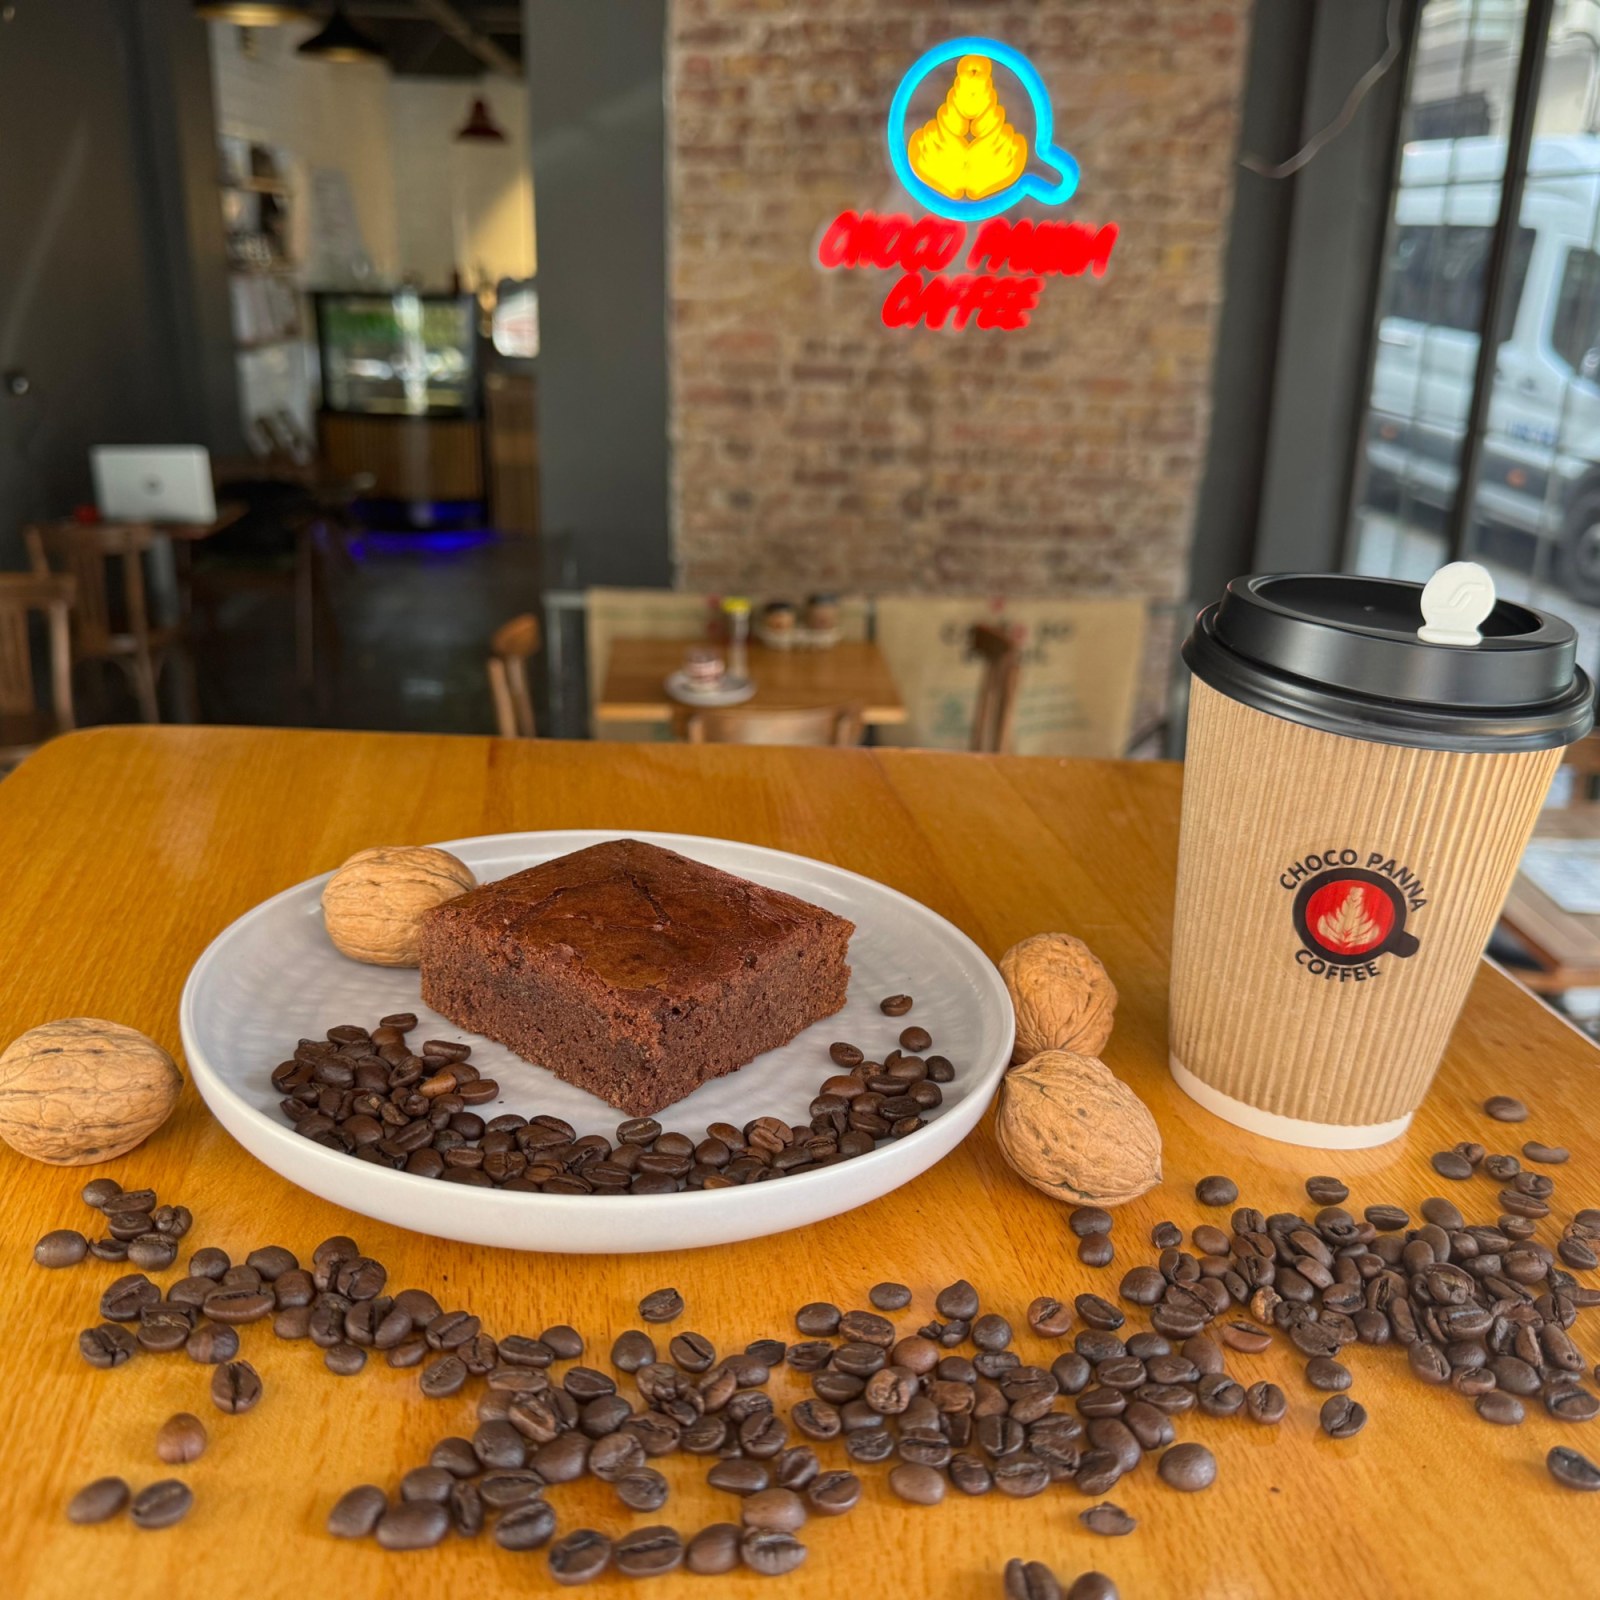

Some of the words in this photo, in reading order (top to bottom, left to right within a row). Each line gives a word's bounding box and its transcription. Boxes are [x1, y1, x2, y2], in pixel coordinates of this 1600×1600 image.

[818, 209, 967, 271] CHOCO
[1279, 848, 1358, 890] CHOCO
[1366, 852, 1428, 912] PANNA
[1294, 948, 1381, 982] COFFEE
